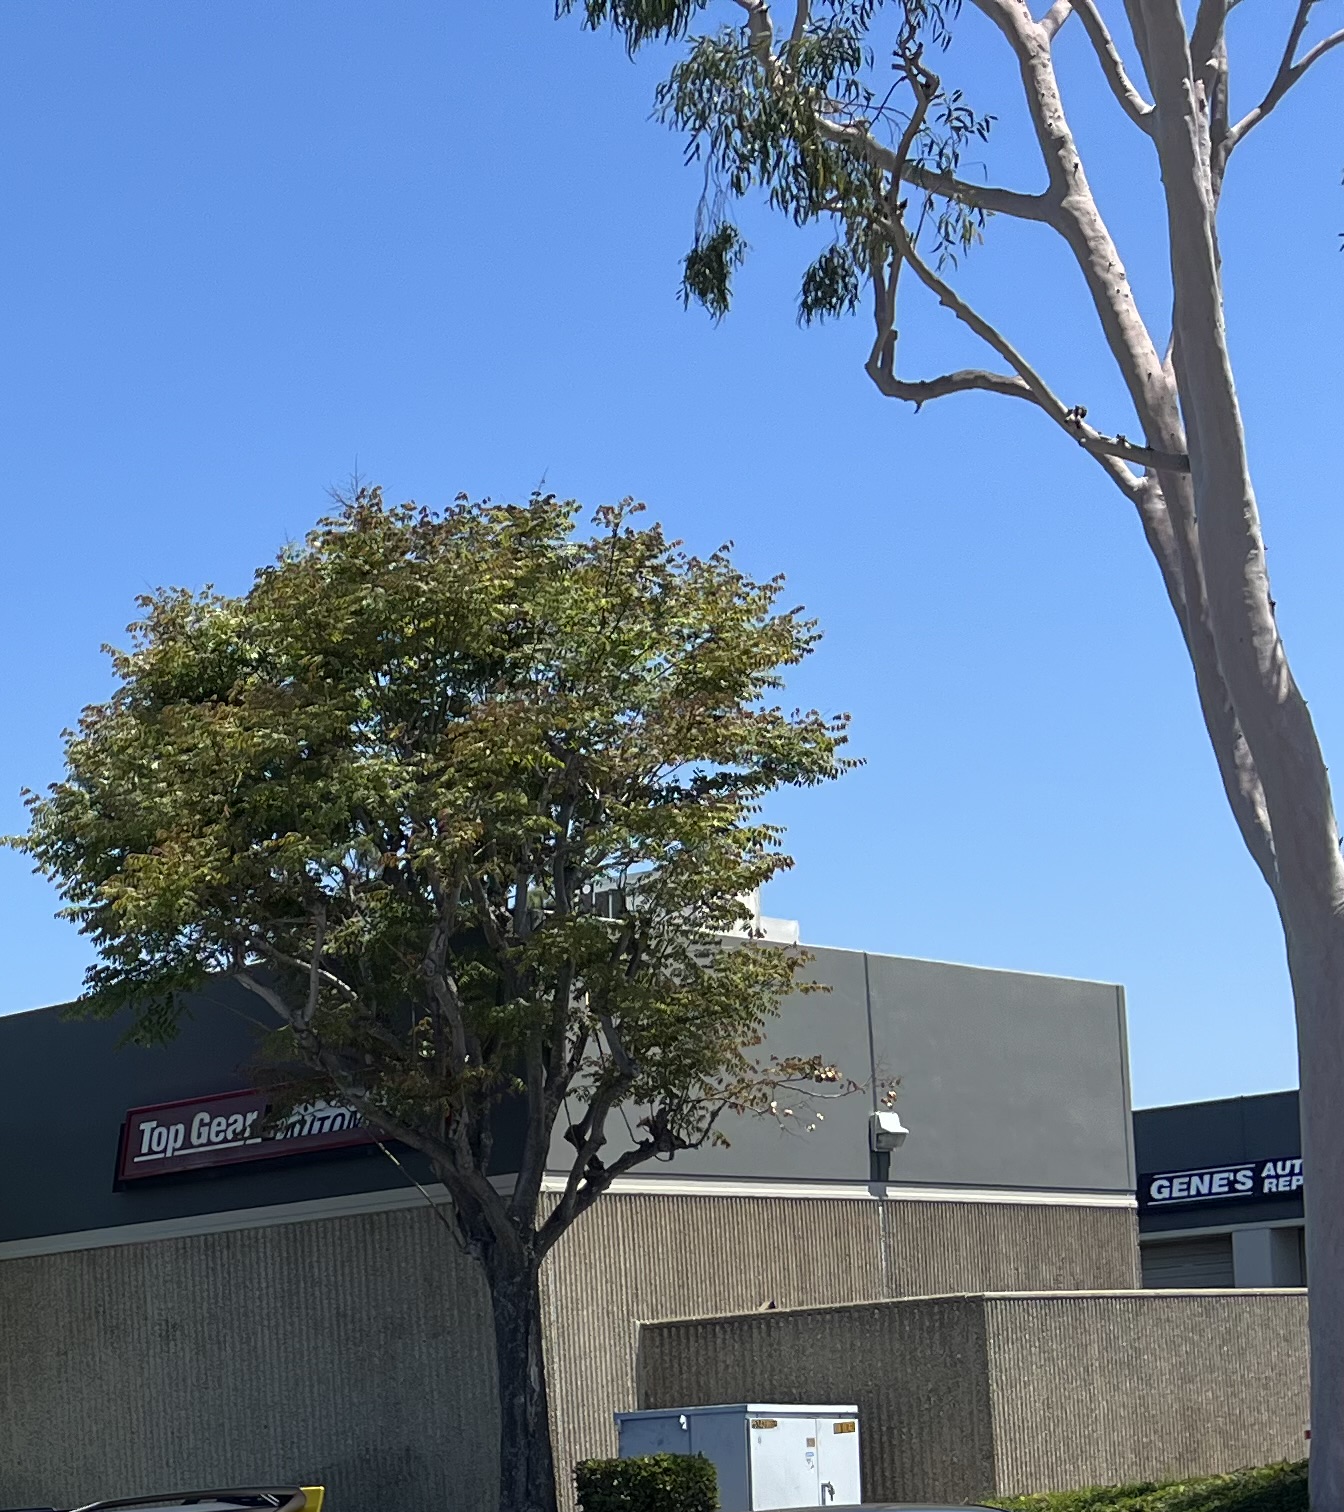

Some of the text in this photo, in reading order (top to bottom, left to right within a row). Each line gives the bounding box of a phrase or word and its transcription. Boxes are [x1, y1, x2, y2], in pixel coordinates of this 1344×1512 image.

[139, 1120, 185, 1157] Top
[190, 1110, 259, 1147] Gear
[1150, 1159, 1304, 1200] GENE'S AUT
[1263, 1177, 1304, 1194] REP
